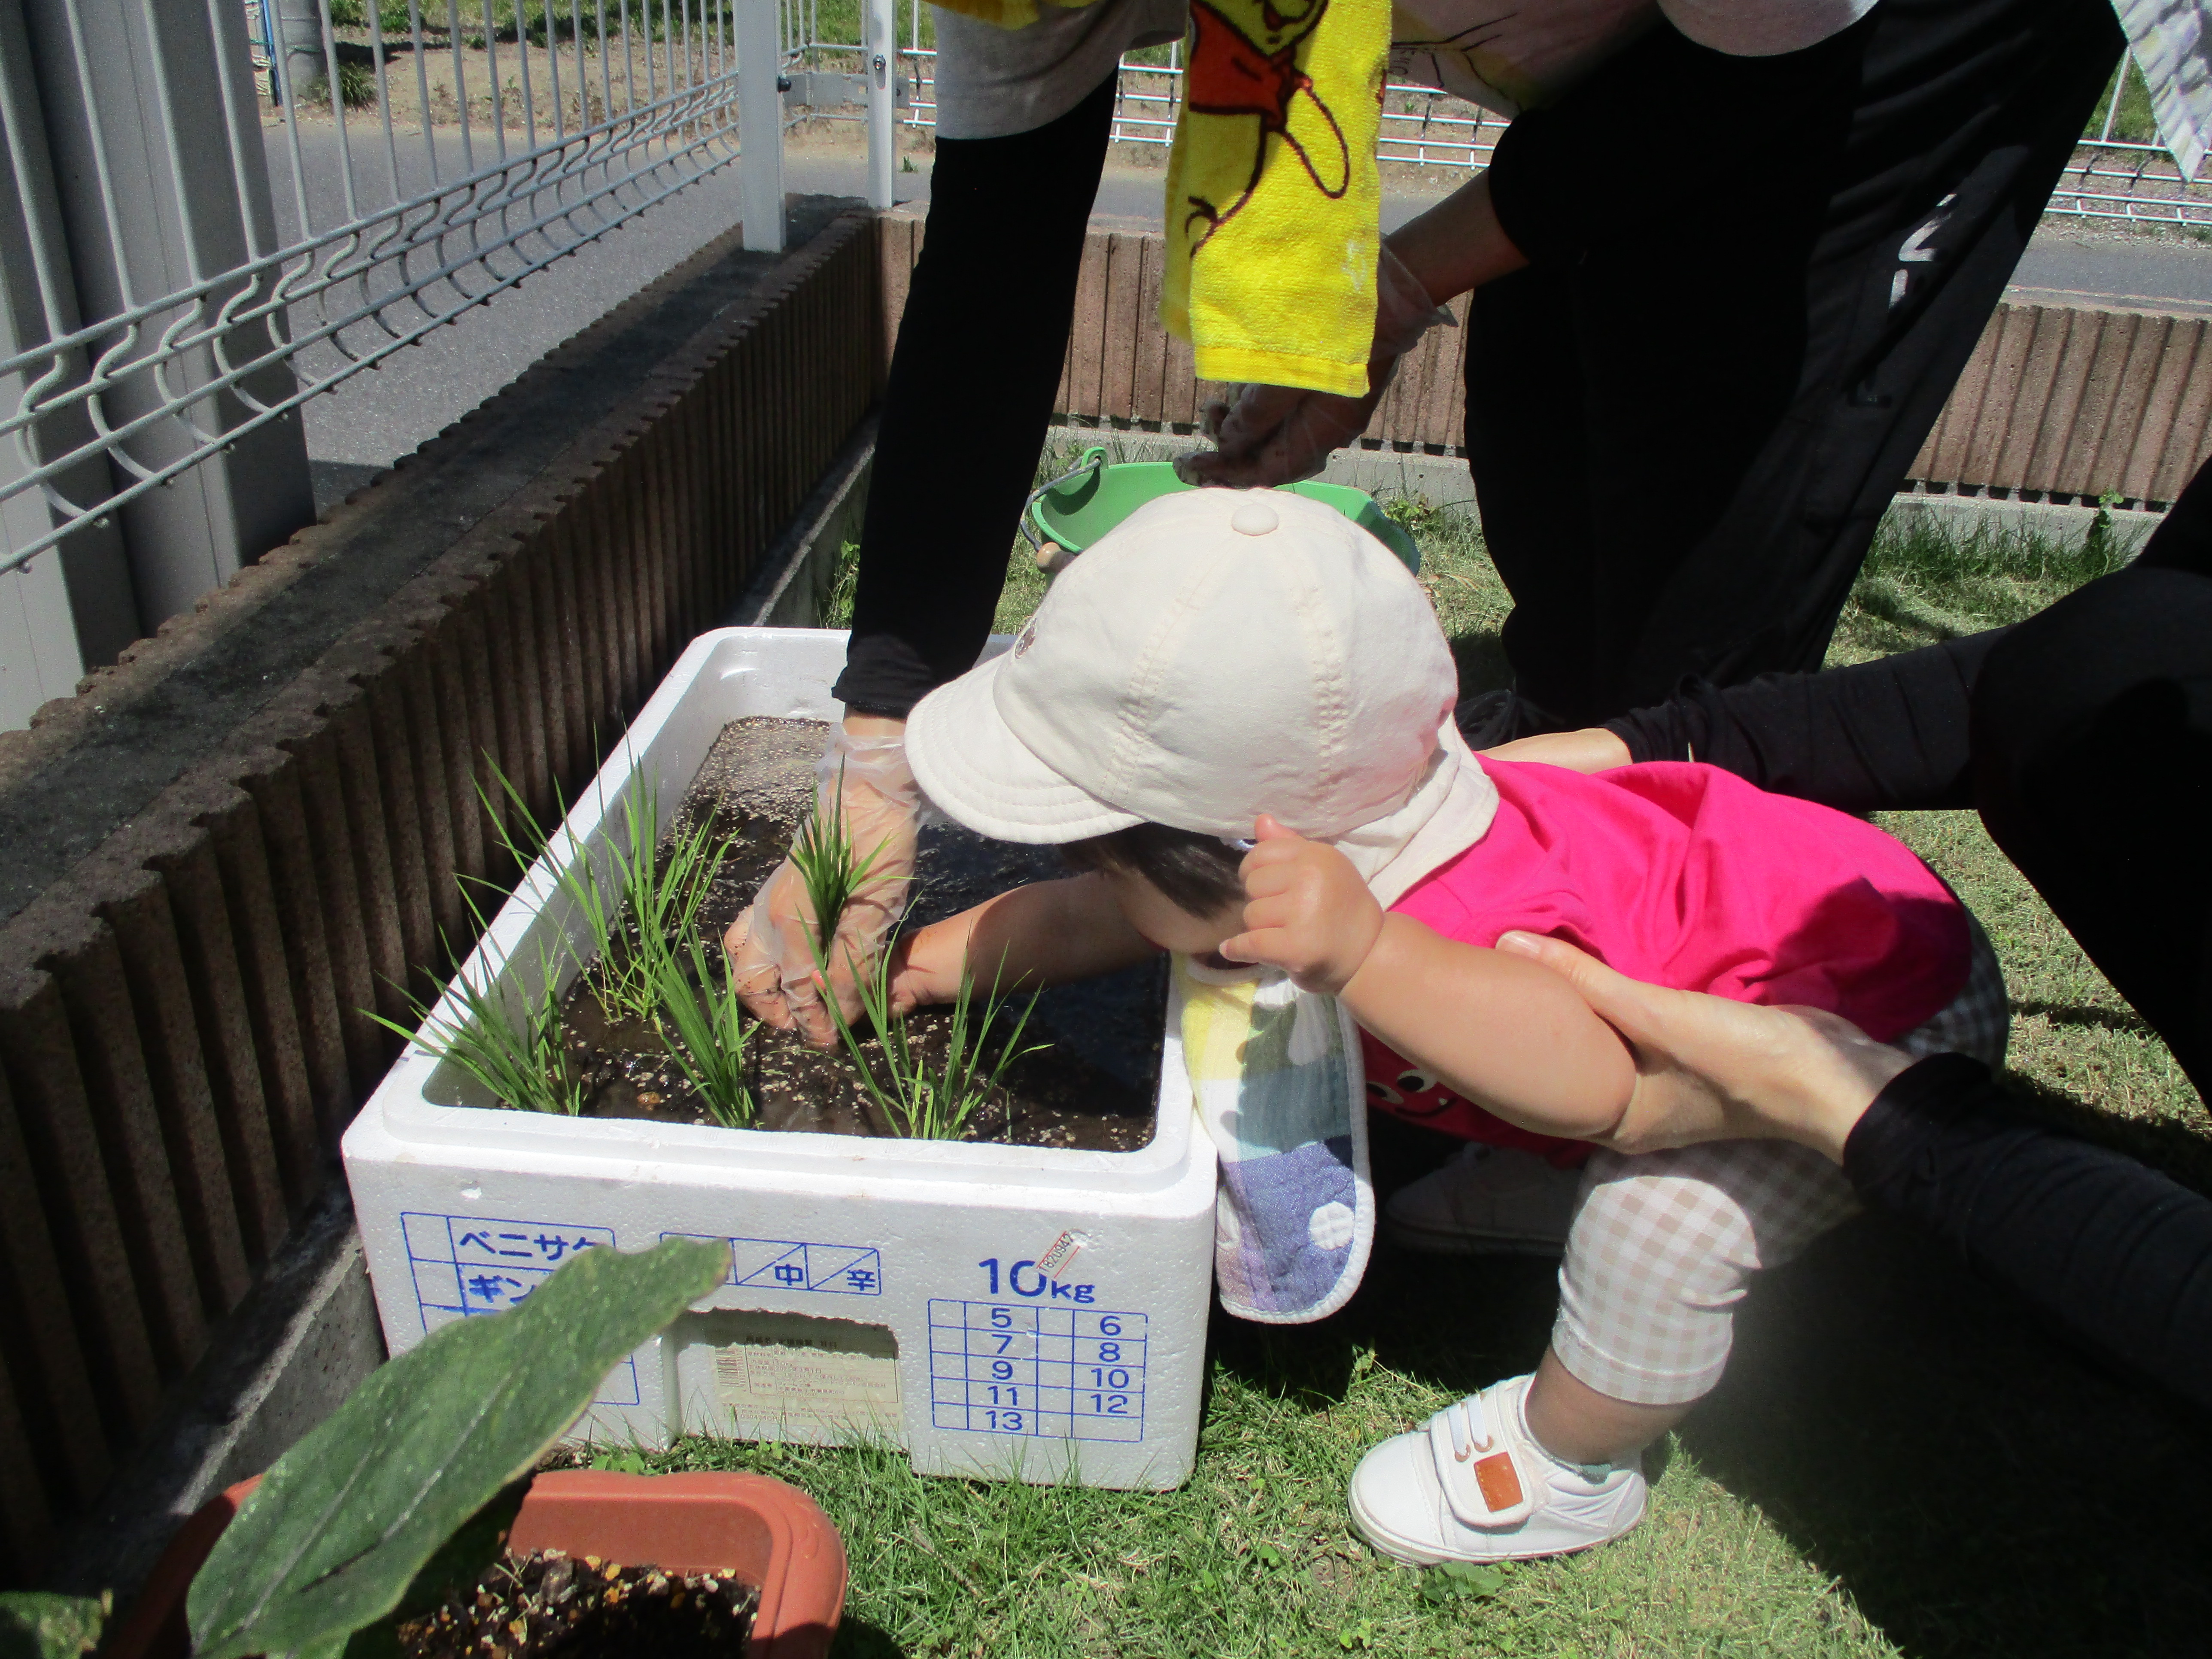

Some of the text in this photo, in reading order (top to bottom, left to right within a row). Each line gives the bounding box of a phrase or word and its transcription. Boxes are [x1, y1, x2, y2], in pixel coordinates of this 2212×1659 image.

[774, 1263, 876, 1291] 中 辛
[991, 1308, 1121, 1337] 5 6
[992, 1334, 1121, 1363] 7 8
[992, 1360, 1130, 1389] 9 10
[988, 1386, 1128, 1414] 11 12
[986, 1410, 1024, 1431] 13
